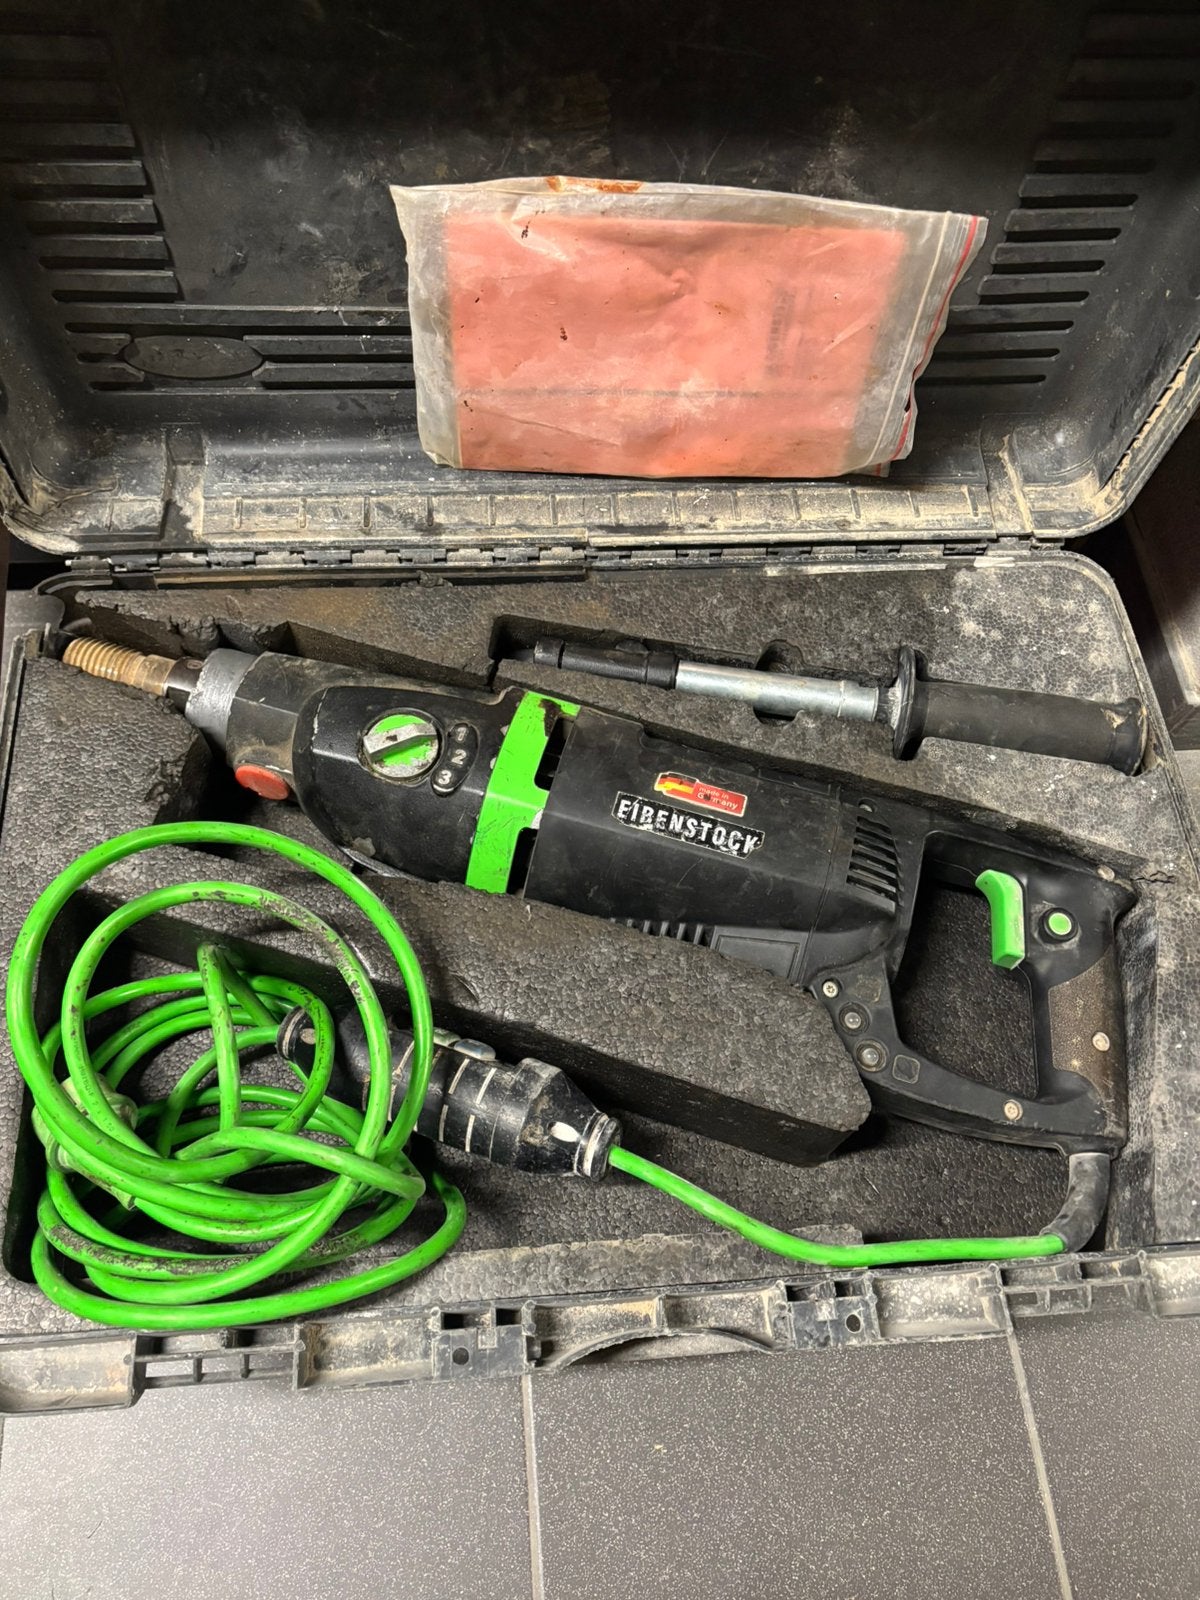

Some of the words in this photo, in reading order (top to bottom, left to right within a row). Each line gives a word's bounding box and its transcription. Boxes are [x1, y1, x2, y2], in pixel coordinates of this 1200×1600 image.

[456, 726, 468, 742] 1
[450, 748, 468, 766] 2
[438, 769, 453, 785] 3
[698, 786, 721, 798] made
[721, 792, 730, 800] in
[616, 798, 761, 855] EIBENSTOCK
